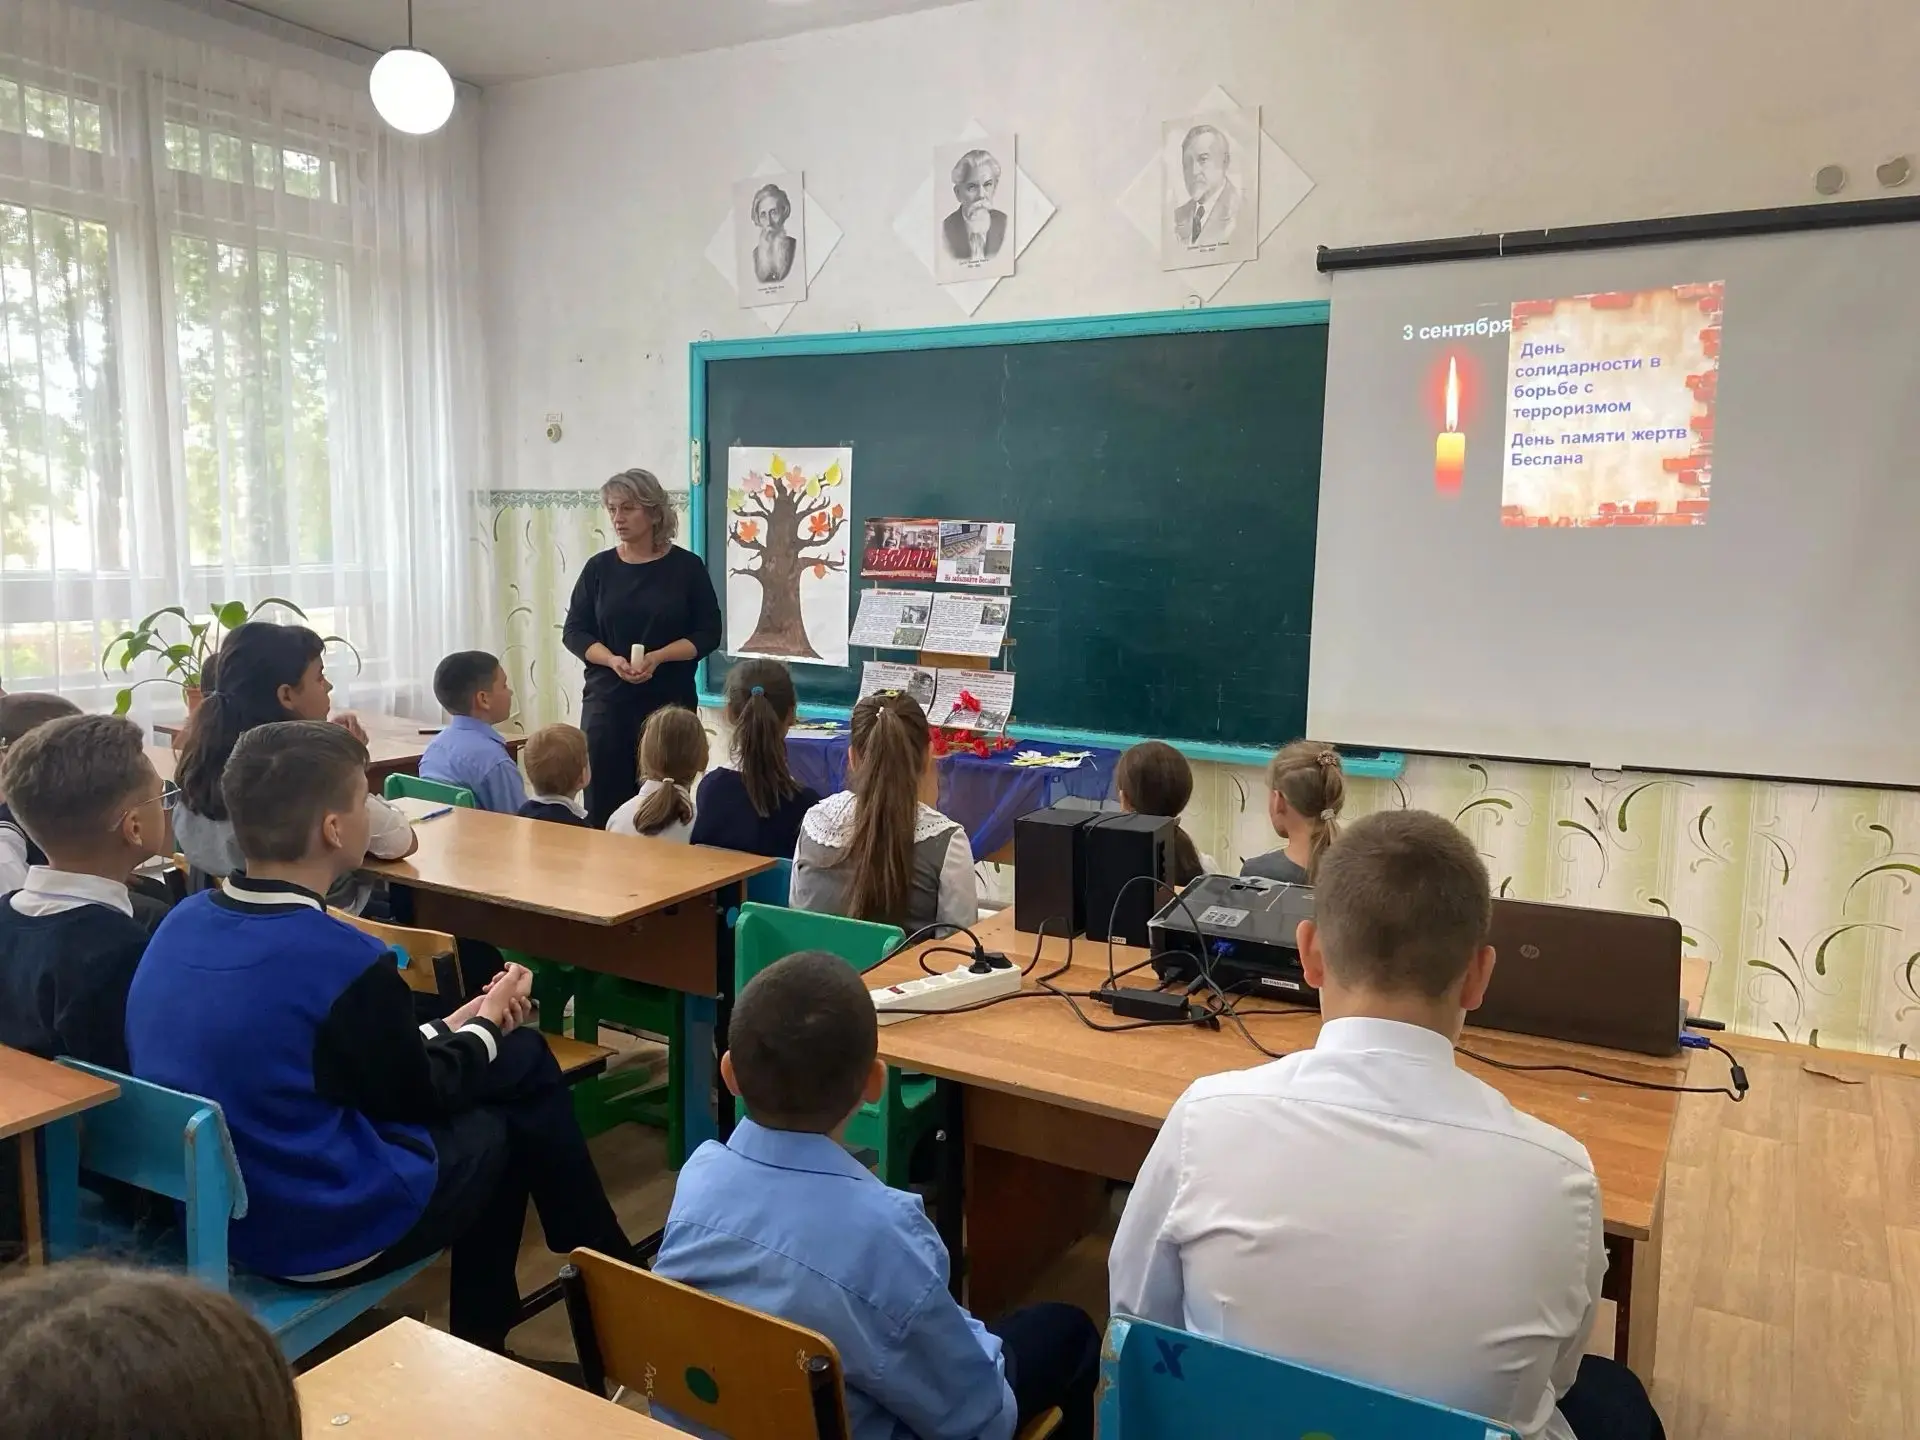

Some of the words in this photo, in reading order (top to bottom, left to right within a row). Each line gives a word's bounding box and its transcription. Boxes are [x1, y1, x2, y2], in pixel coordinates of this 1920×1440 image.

[1403, 324, 1413, 340] 3
[1419, 317, 1512, 339] сентября
[1520, 343, 1565, 358] День
[1515, 357, 1642, 378] солидарности
[1650, 356, 1661, 368] в
[1514, 382, 1578, 399] борьбе
[1584, 383, 1594, 393] с
[1513, 400, 1631, 420] терроризмом
[1511, 432, 1555, 449] День
[1561, 430, 1625, 445] памяти
[1631, 427, 1687, 443] жертв
[1511, 452, 1583, 466] Беслана
